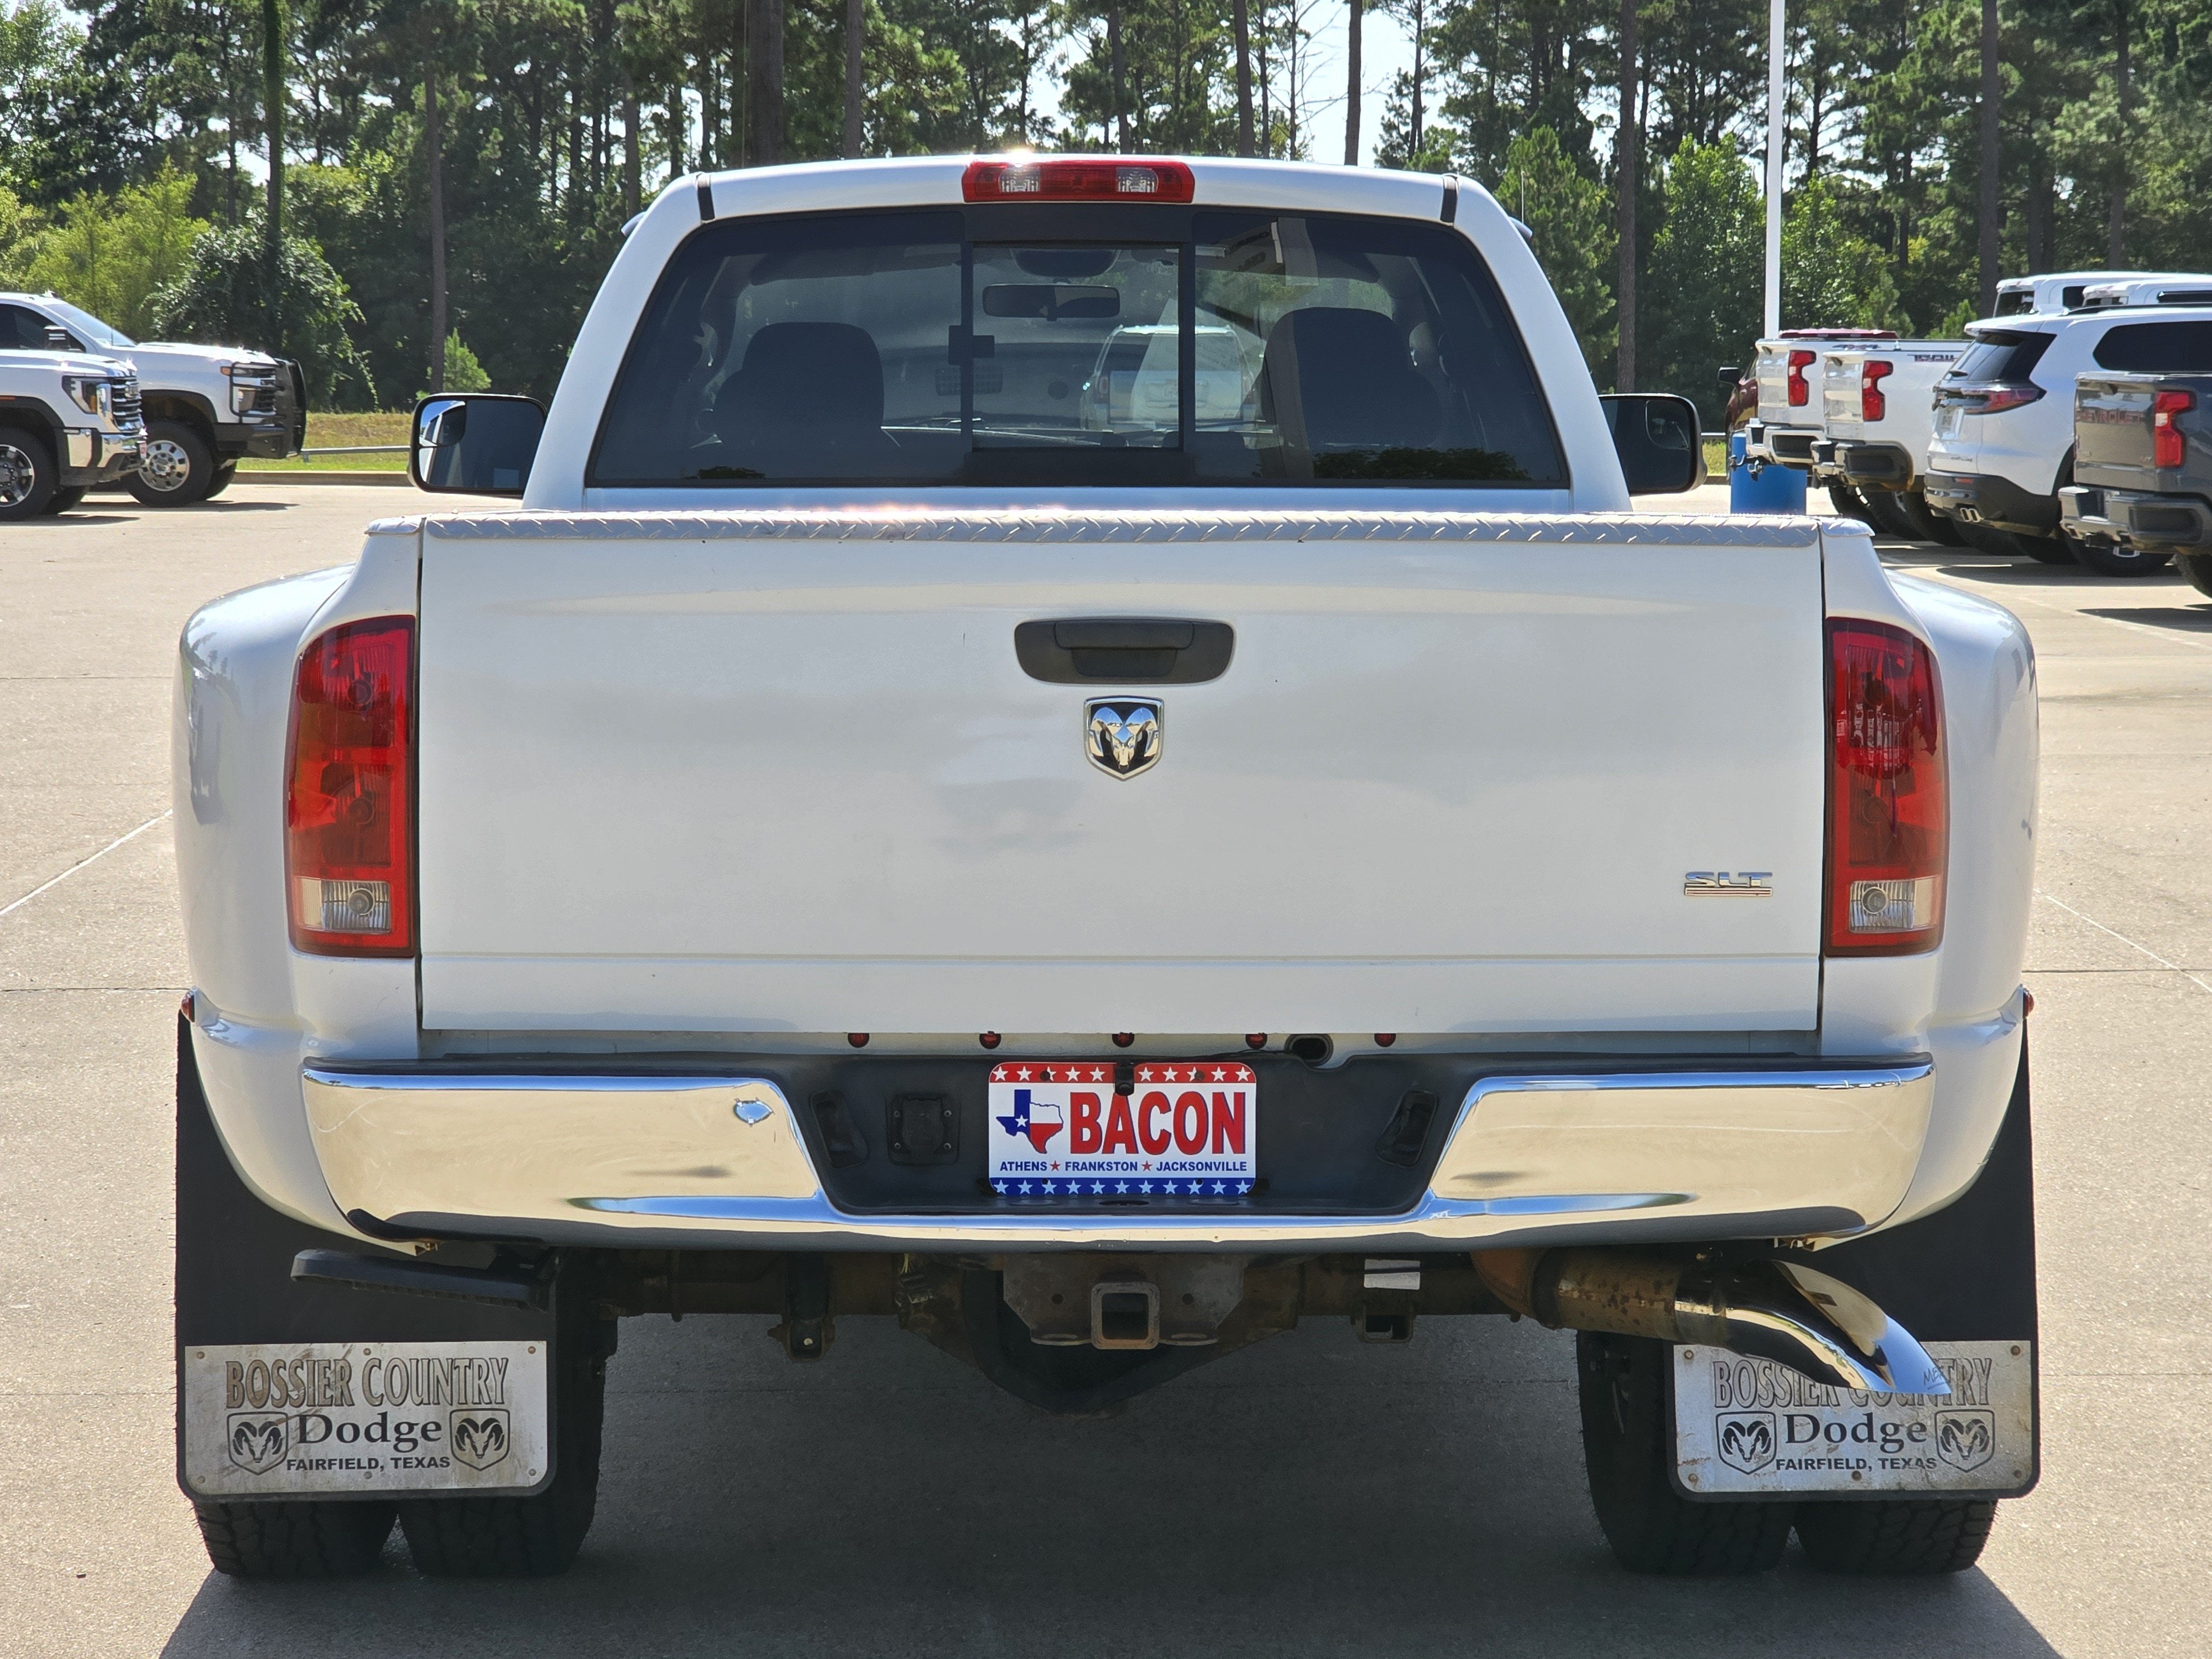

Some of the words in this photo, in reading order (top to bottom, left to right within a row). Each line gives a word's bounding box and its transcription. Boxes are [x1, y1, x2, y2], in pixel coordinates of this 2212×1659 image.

[1684, 871, 1773, 888] SLT
[1070, 1091, 1246, 1155] BACON
[999, 1161, 1047, 1172] ATHENS
[1065, 1161, 1138, 1172] FRANKSTON
[1156, 1161, 1248, 1172] JACKSONVILLE
[225, 1358, 355, 1410] BOSSIER
[362, 1358, 509, 1407] COUNTRY
[296, 1411, 442, 1453] Dodge
[1782, 1411, 1927, 1454] Dodge
[286, 1458, 384, 1472] FAIRFIELD,
[389, 1456, 451, 1469] TEXAS
[1776, 1458, 1873, 1472] FAIRFIELD,
[1877, 1457, 1937, 1470] TEXAS
